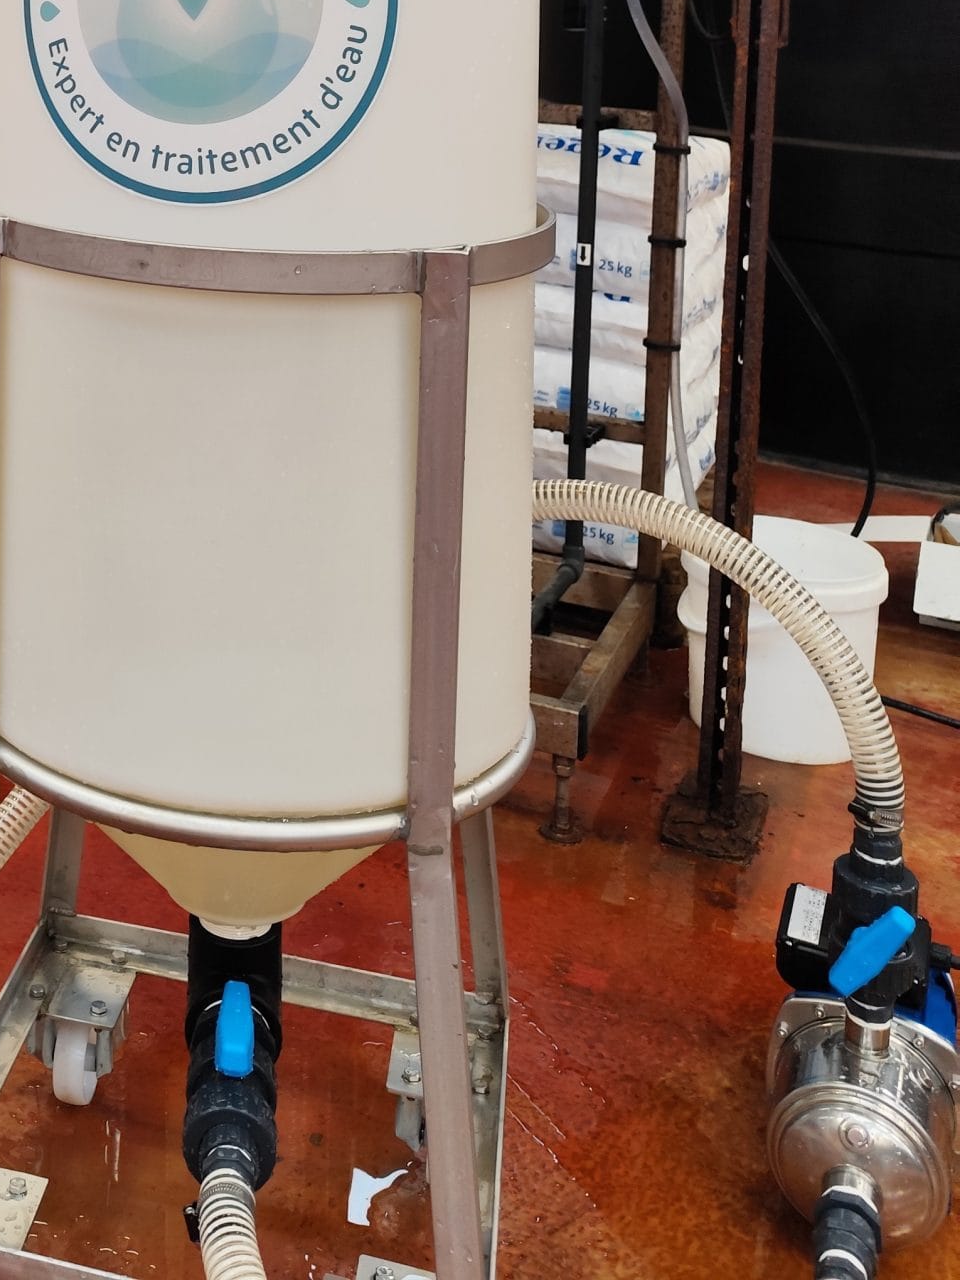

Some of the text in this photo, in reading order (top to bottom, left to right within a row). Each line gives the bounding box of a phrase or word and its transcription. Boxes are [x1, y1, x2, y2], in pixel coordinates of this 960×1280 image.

[48, 24, 369, 176] Expert en traitement d'eau
[598, 258, 632, 278] 25 kg
[598, 528, 615, 546] kg
